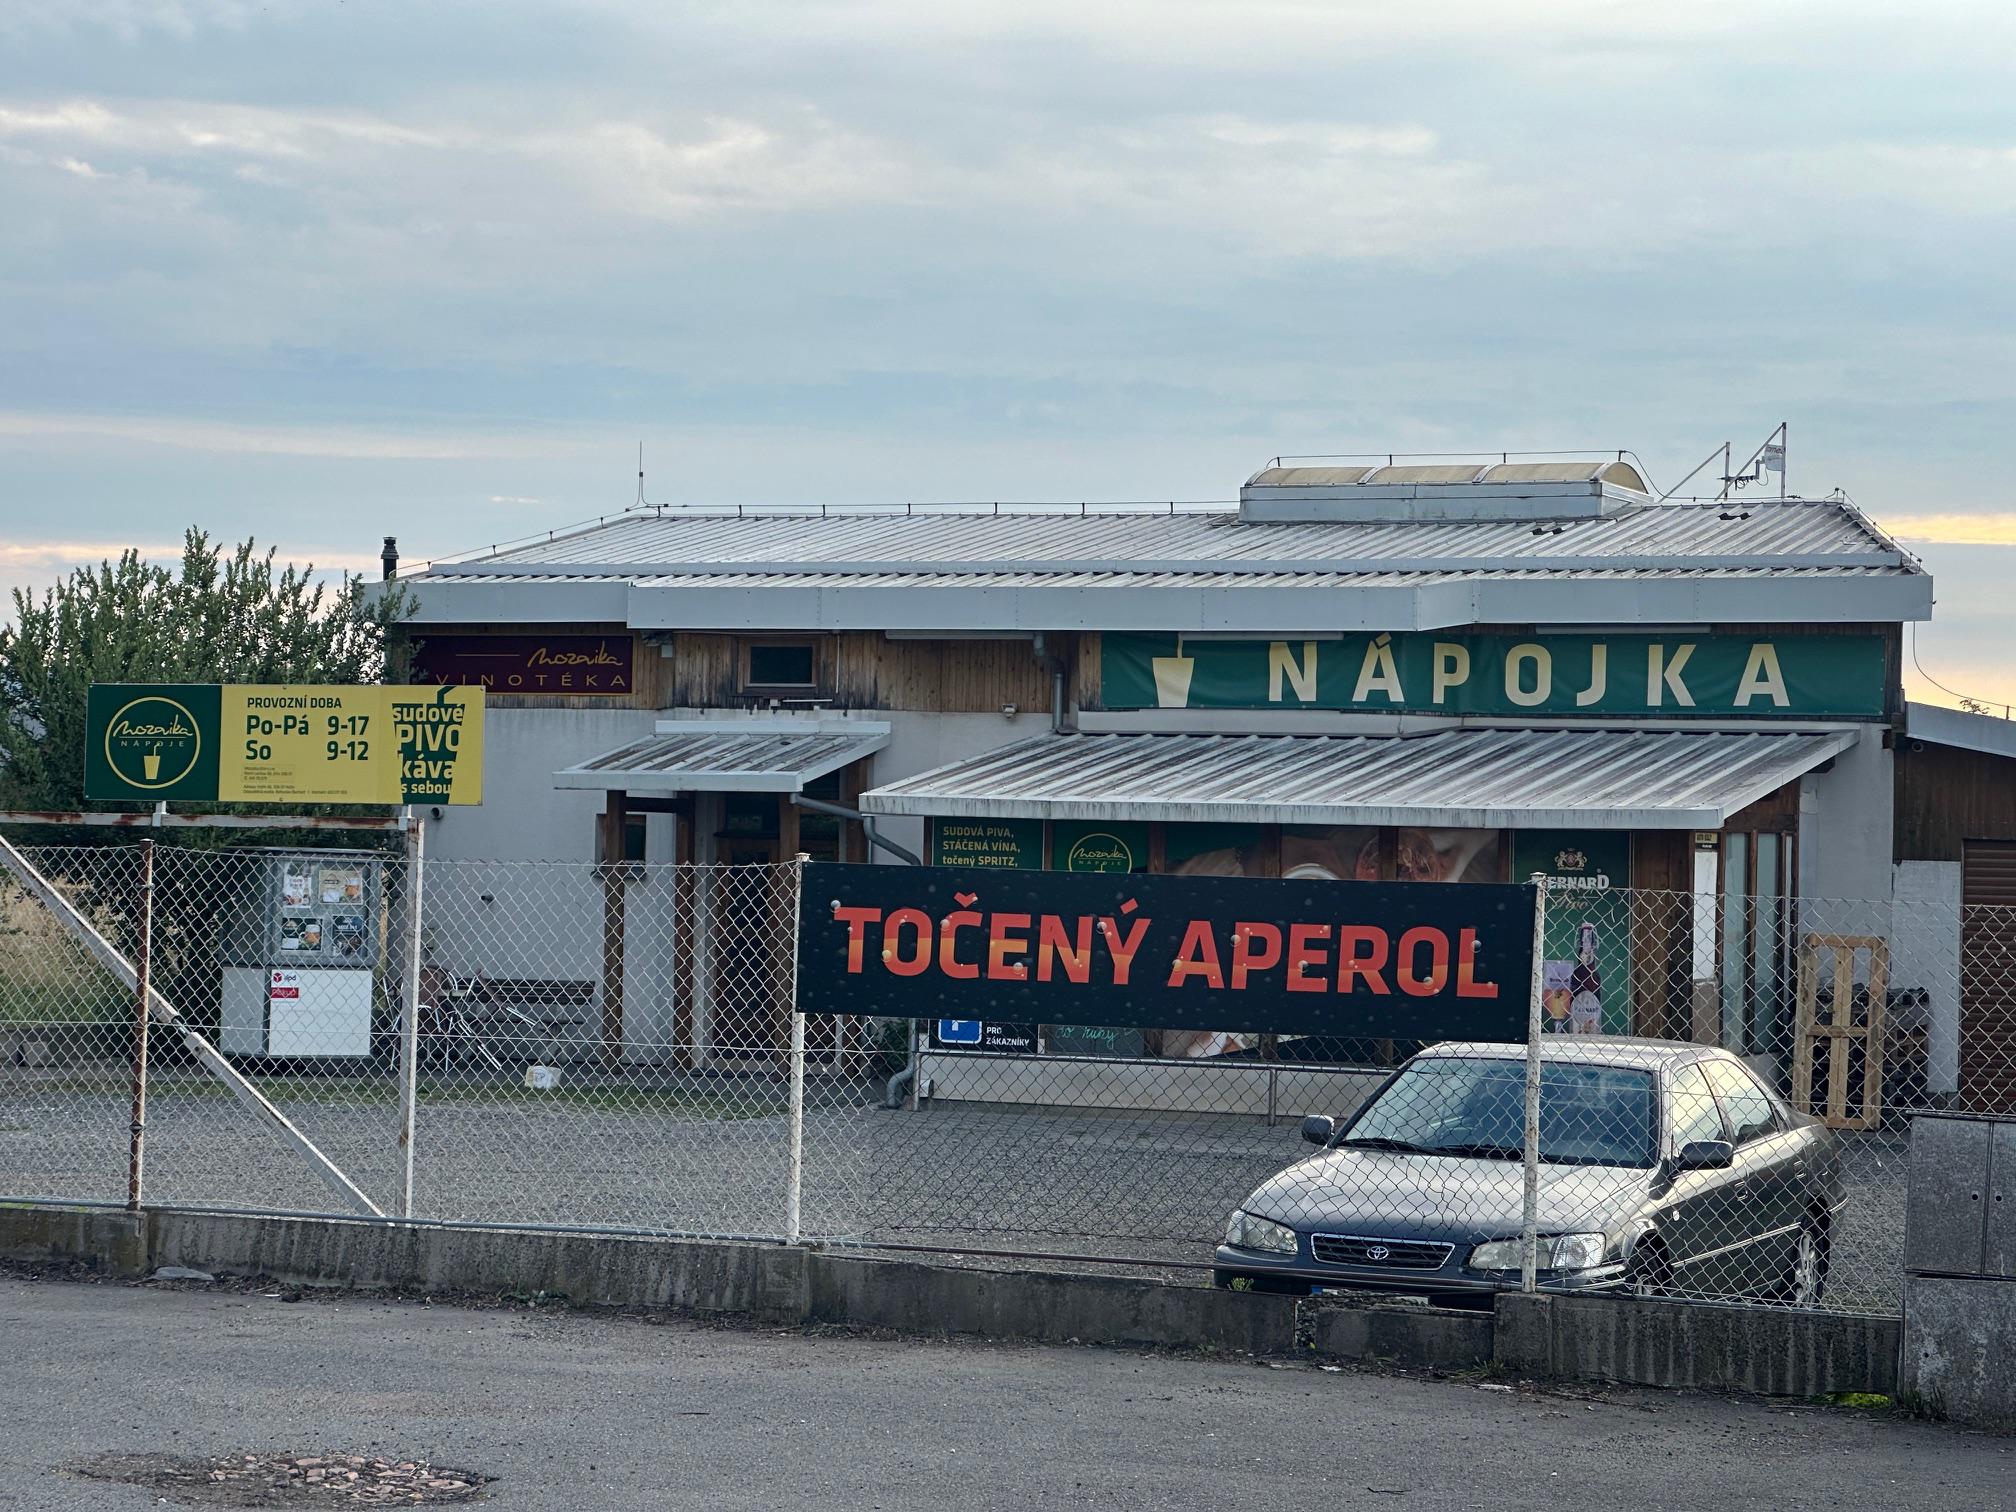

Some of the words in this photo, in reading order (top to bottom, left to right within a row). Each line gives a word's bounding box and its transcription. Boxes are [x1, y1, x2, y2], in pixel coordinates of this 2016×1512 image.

[1268, 631, 1791, 707] NÁPOJKA
[436, 672, 626, 687] VINOTÉKA
[247, 694, 307, 709] PROVOZNÍ
[310, 697, 342, 709] DOBA
[392, 704, 464, 722] sudové
[246, 714, 309, 736] Po-Pá
[327, 715, 370, 736] 9-17
[396, 723, 462, 752] PIVO
[245, 739, 272, 760] So
[326, 740, 369, 761] 9-12
[399, 753, 455, 779] káva
[401, 783, 408, 794] s
[411, 780, 451, 794] sebou
[943, 825, 985, 837] SUDOVÁ
[986, 827, 1014, 838] PIVA,
[942, 838, 989, 851] STÁČENÁ
[991, 840, 1021, 853] VÍNA,
[942, 855, 976, 867] točený
[978, 856, 1018, 868] SPRITZ,
[833, 891, 1152, 985] TOČENÝ
[1167, 920, 1499, 998] APEROL
[986, 1026, 1003, 1035] PRO
[986, 1036, 1030, 1047] ZÁKAZNÍKY
